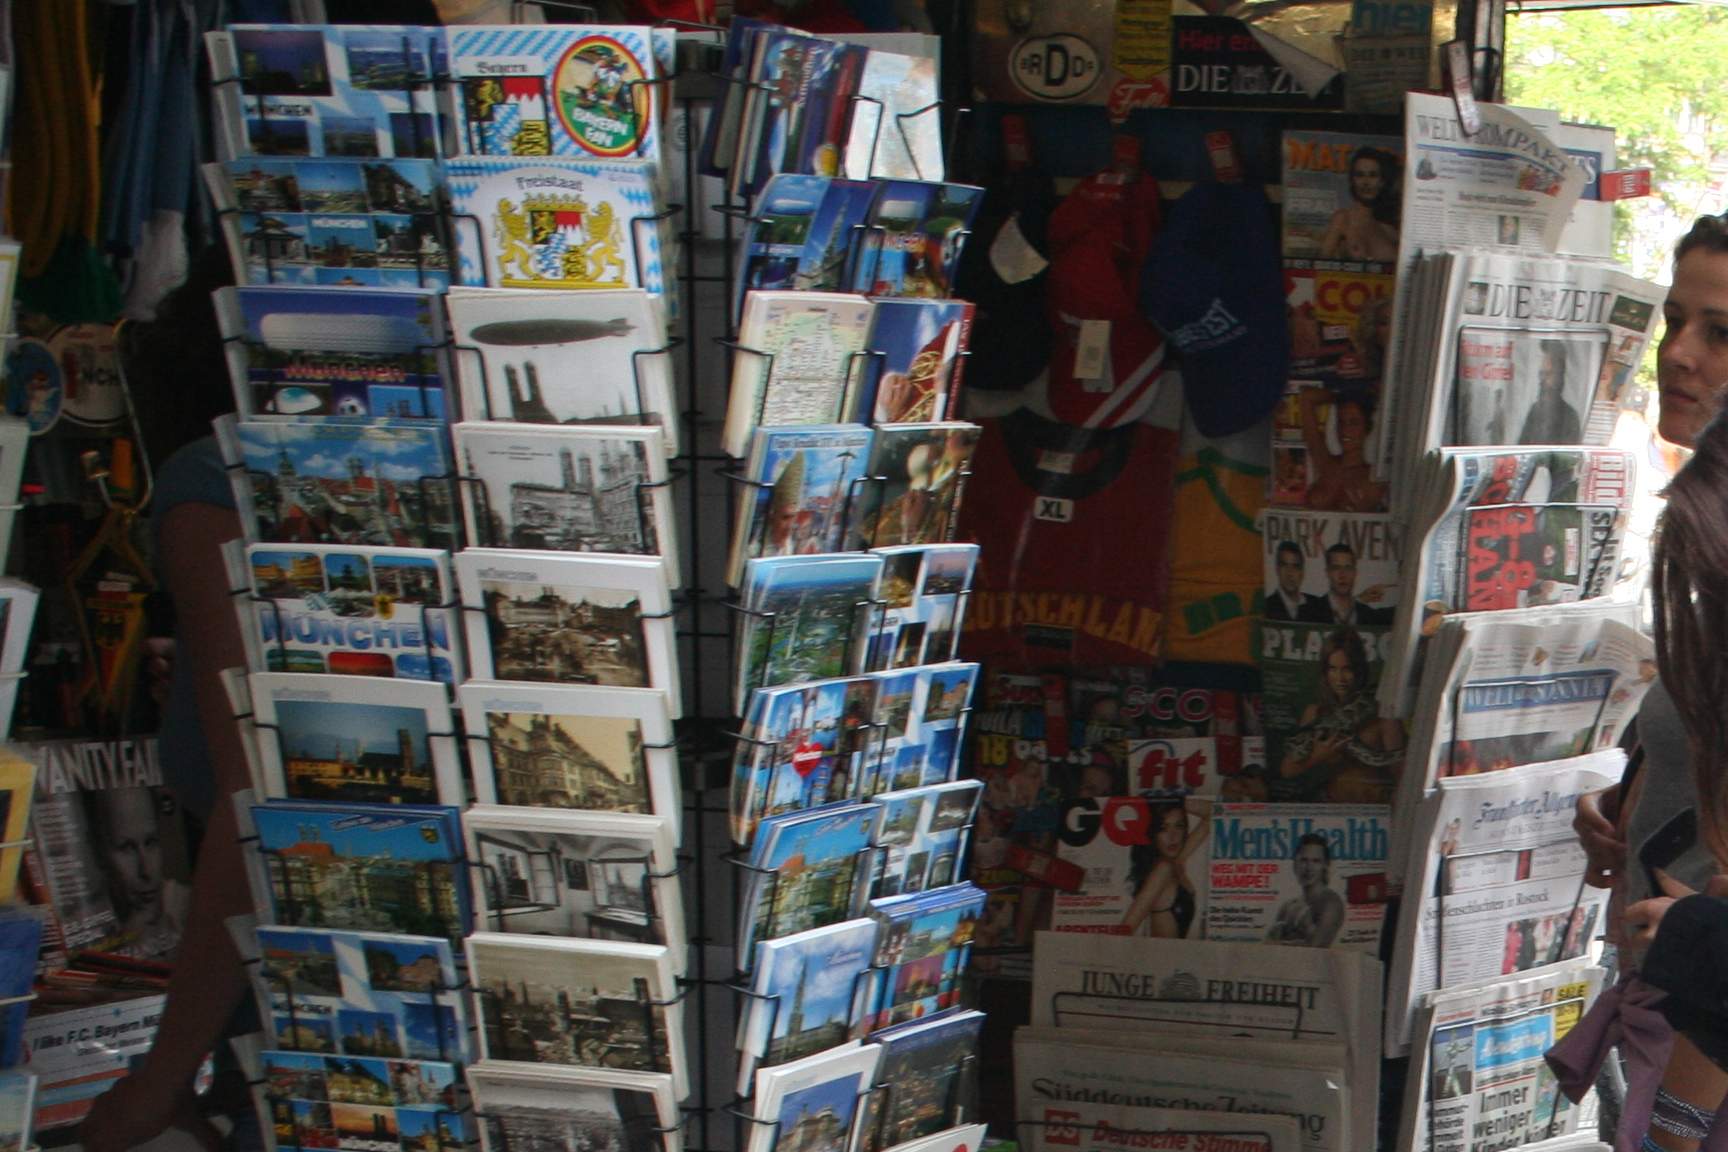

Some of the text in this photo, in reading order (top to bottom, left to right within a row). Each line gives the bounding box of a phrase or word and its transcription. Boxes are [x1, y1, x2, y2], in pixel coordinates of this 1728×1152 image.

[1176, 64, 1230, 93] DIE
[1488, 284, 1611, 324] DIE ZEIT
[1038, 501, 1067, 520] XL
[1266, 514, 1326, 560] PARK
[259, 607, 450, 652] MÜNCHEN
[1056, 796, 1153, 848] GQ
[1212, 818, 1289, 861] Men's
[1082, 969, 1321, 1011] JUNGE FREIHEIT
[1091, 1119, 1189, 1151] Deutsche
